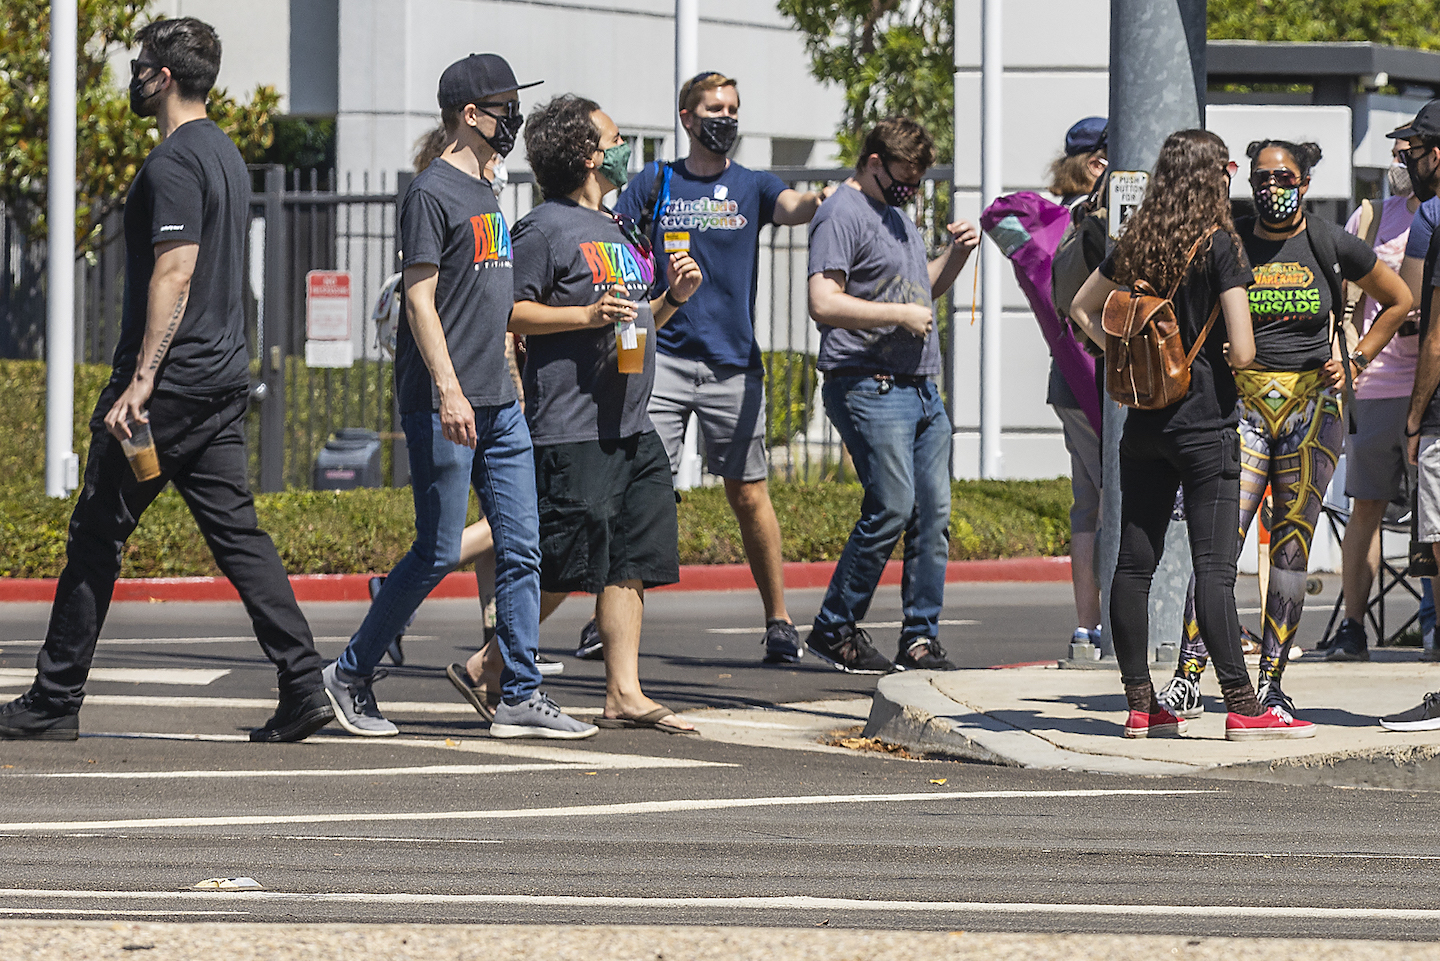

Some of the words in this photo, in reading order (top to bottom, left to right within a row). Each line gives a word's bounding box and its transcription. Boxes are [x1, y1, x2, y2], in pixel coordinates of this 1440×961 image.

[470, 212, 514, 263] BLIZZA
[1247, 288, 1320, 302] URNING
[1249, 300, 1321, 315] RUSADE
